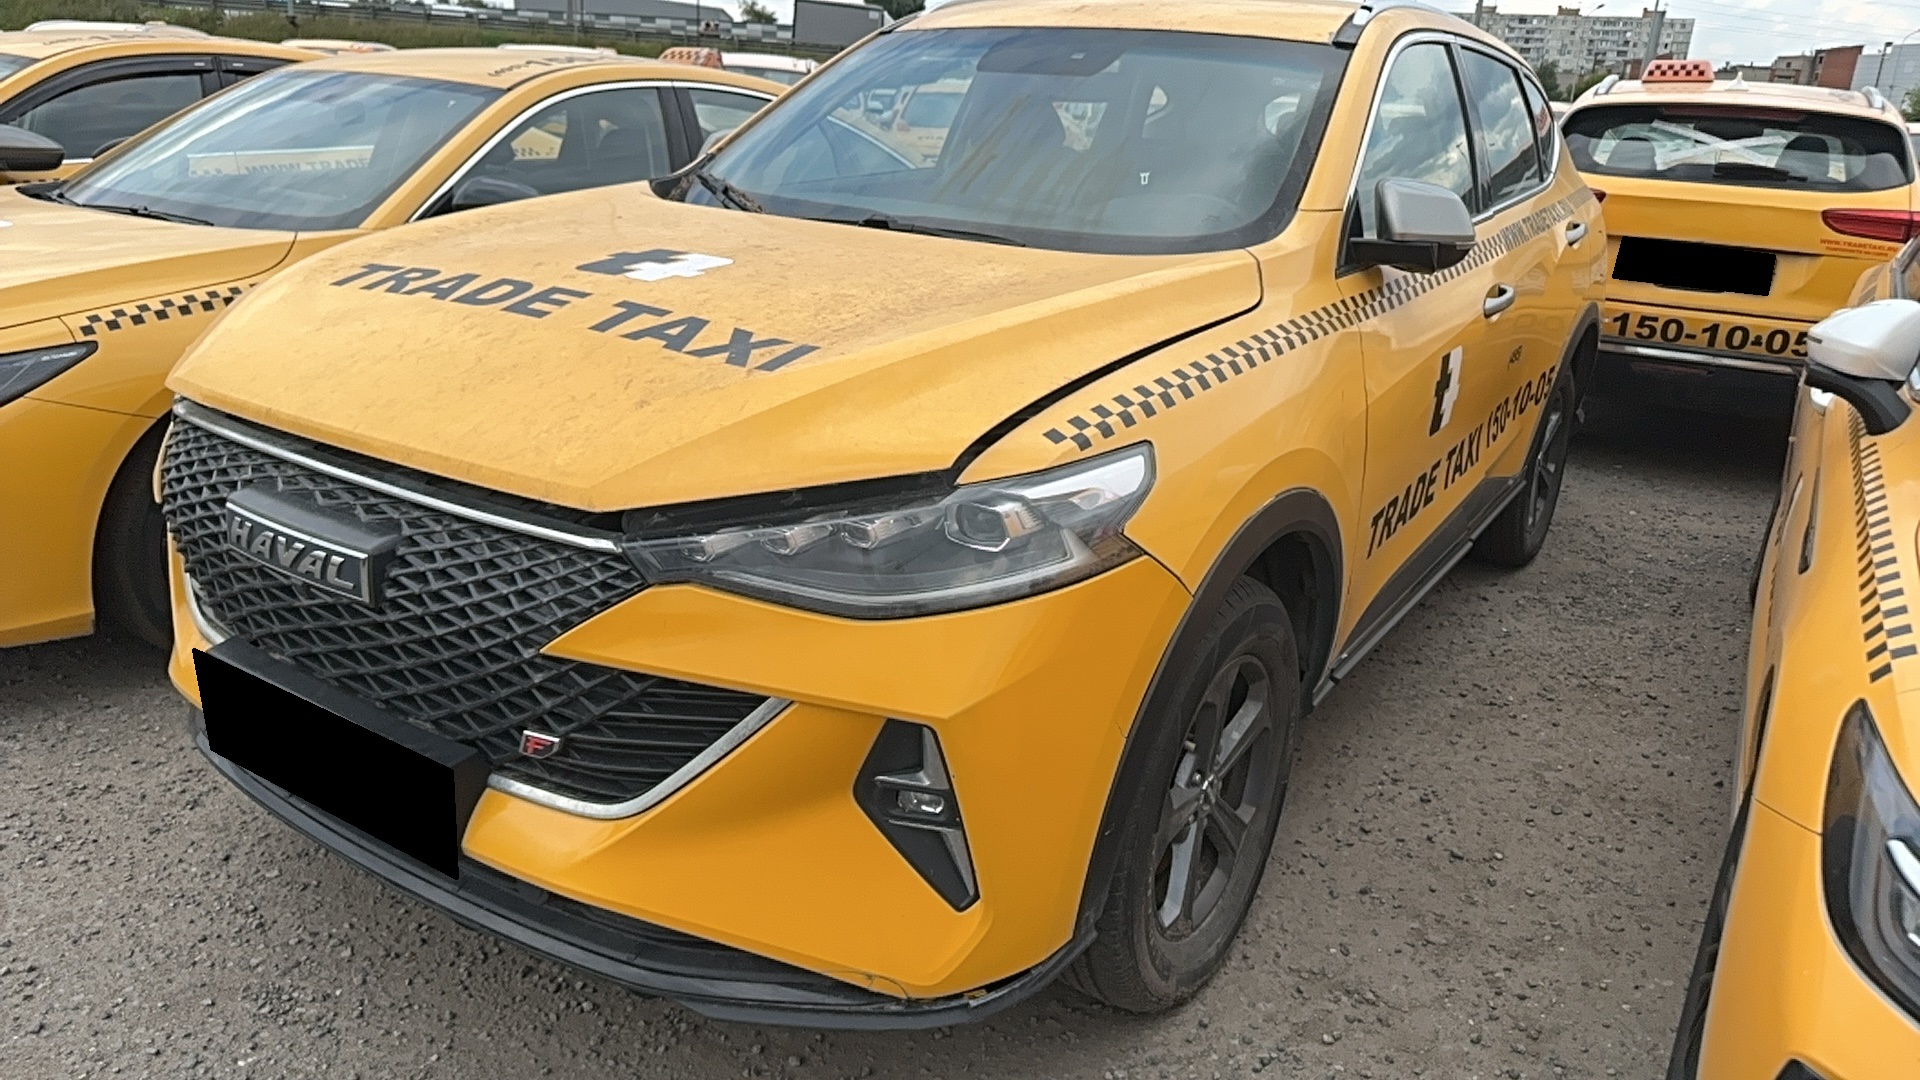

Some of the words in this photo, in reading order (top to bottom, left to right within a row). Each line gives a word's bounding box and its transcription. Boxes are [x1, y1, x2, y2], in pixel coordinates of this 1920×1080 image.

[329, 263, 593, 319] TRADE
[587, 300, 823, 372] TAXI
[1612, 312, 1808, 357] 150-10-05
[1367, 459, 1441, 560] TRADE
[1444, 423, 1484, 490] TAXI
[1486, 365, 1556, 448] 150-10-05
[230, 516, 355, 590] HAVAL
